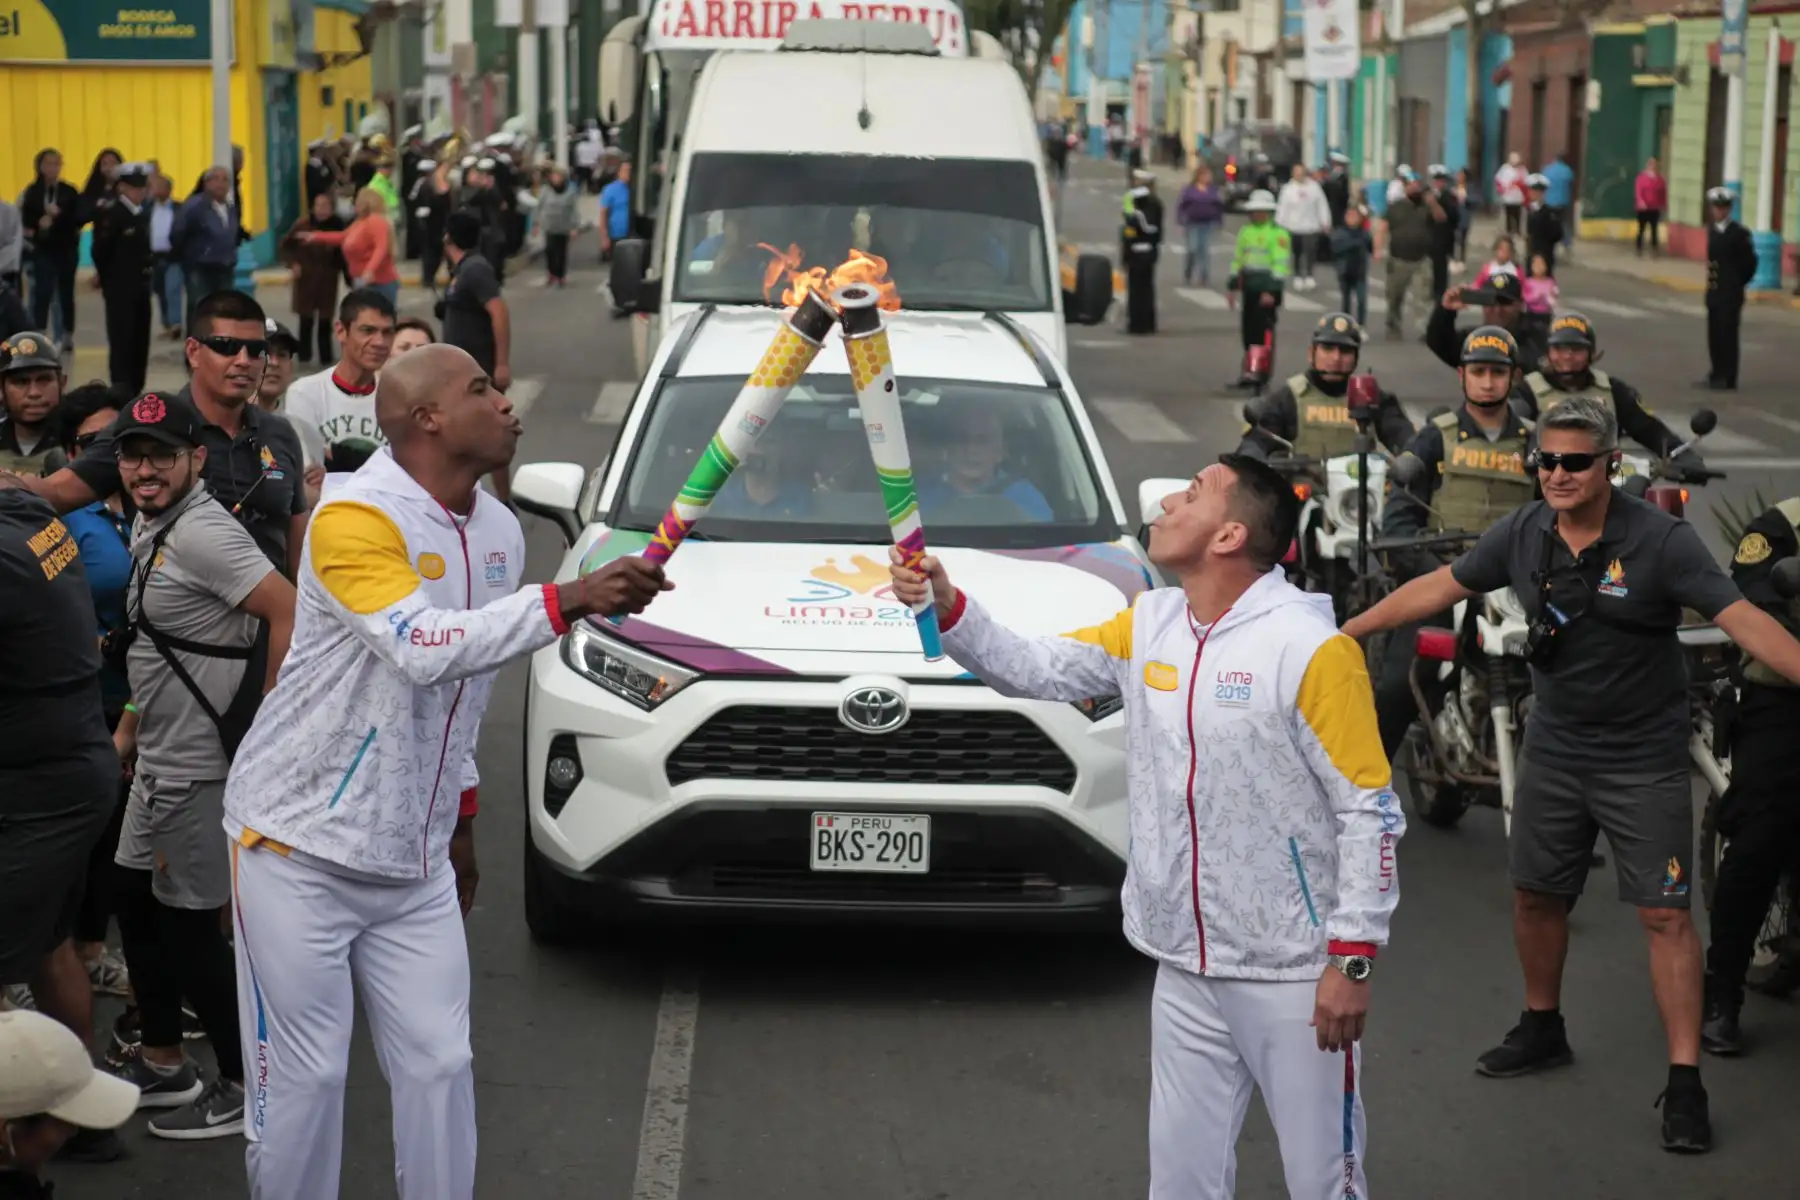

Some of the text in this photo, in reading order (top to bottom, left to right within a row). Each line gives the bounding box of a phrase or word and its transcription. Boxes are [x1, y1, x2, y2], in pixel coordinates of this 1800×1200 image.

[319, 414, 354, 441] IVY
[873, 619, 916, 628] ANTO
[1215, 684, 1252, 700] 2019
[851, 817, 892, 830] PERU
[817, 828, 924, 864] BKS-290
